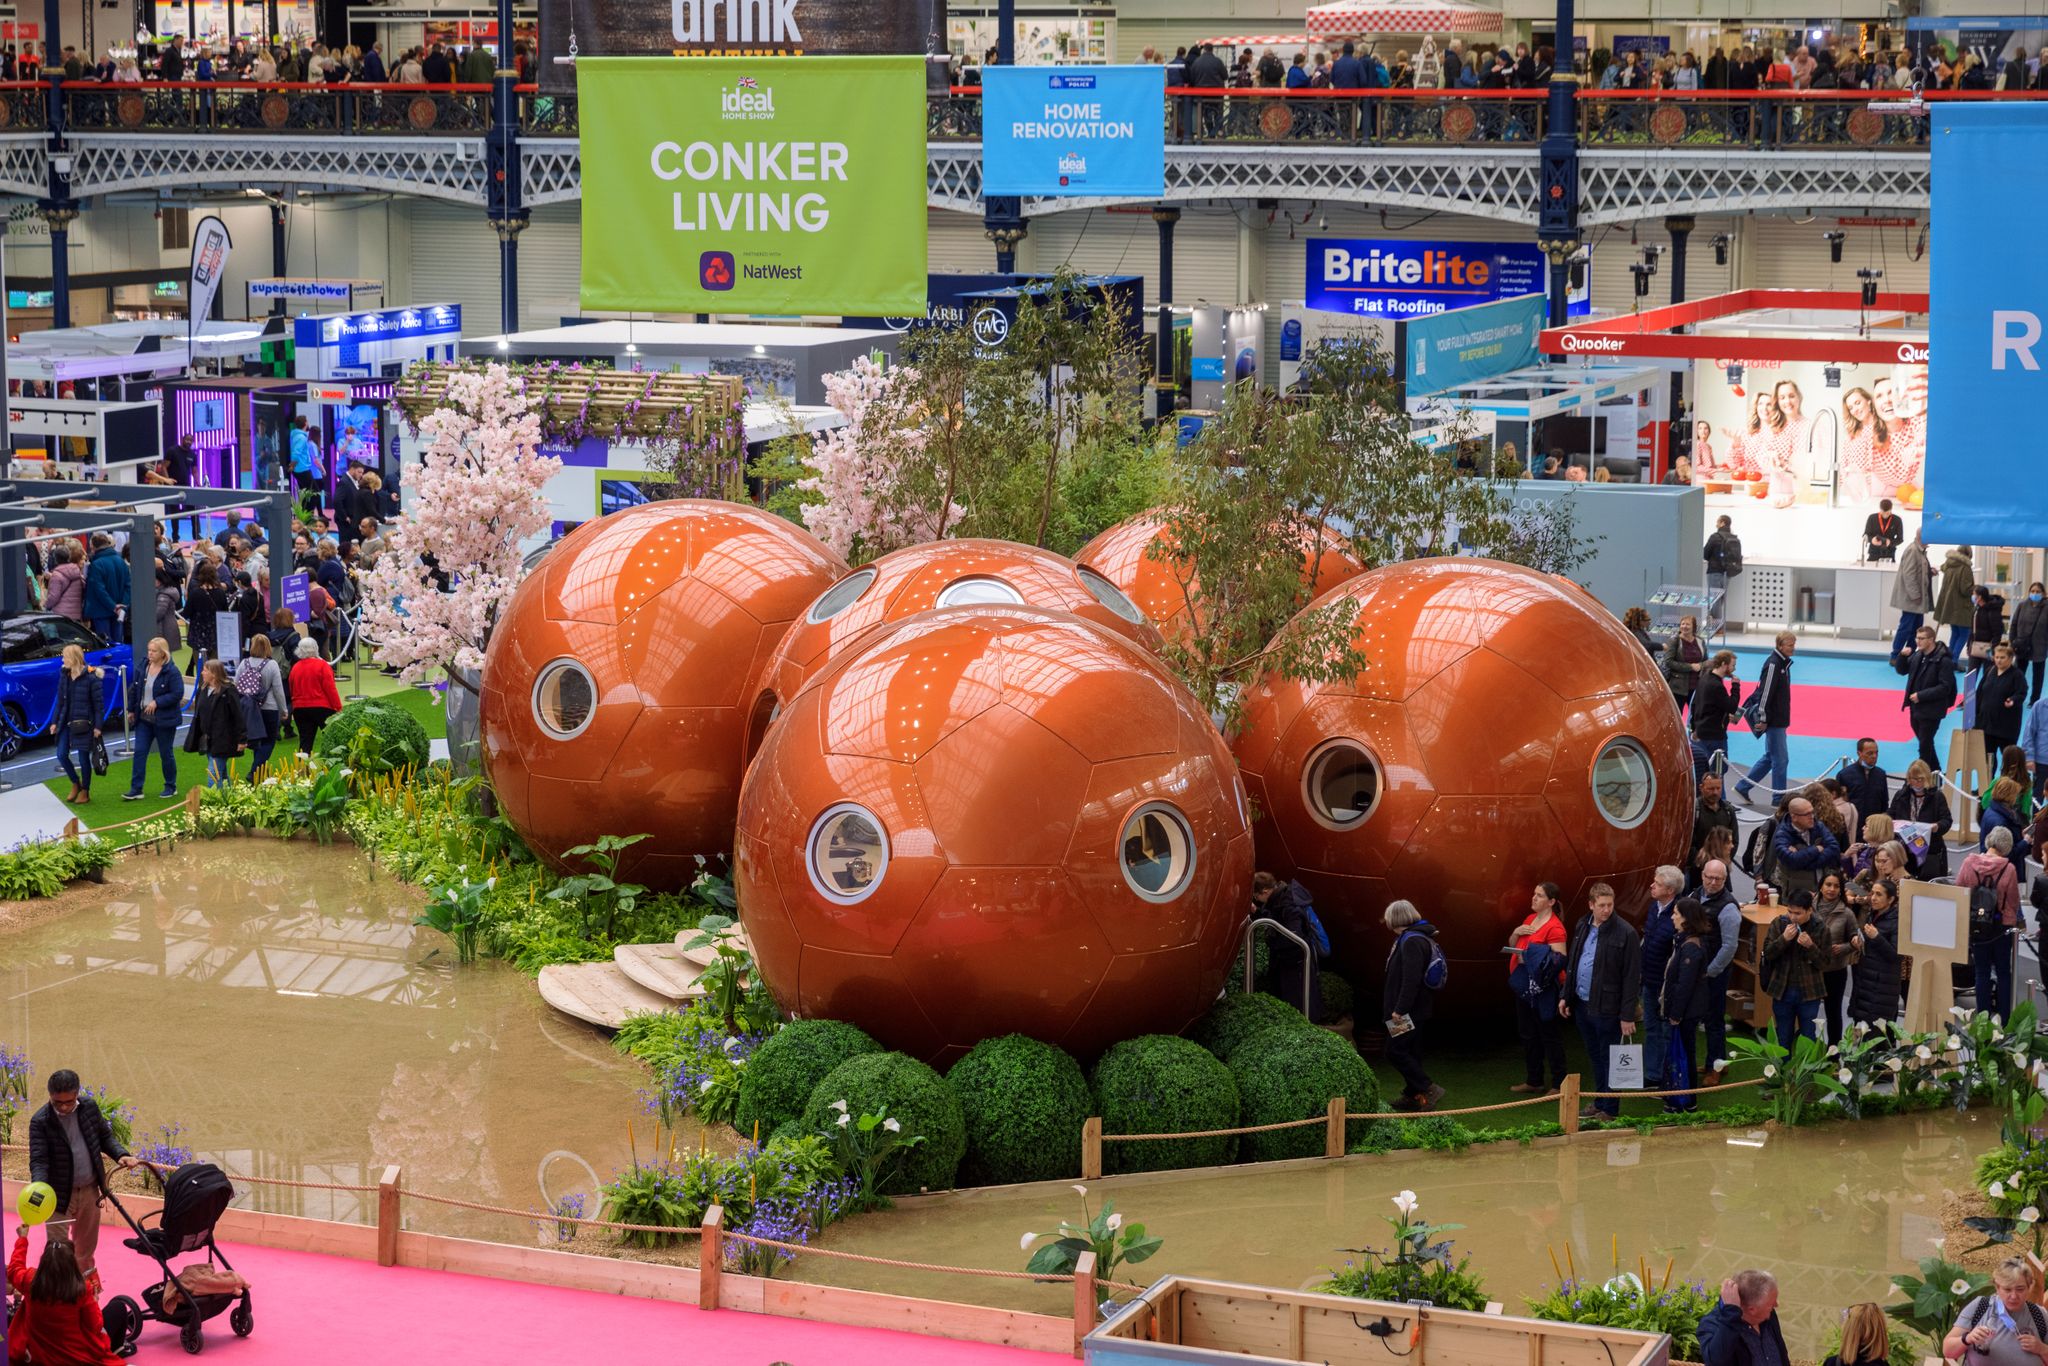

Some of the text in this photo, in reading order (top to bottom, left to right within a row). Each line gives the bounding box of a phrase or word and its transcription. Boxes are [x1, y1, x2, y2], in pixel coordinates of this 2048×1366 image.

[672, 0, 803, 43] drink
[722, 87, 775, 112] ideal
[1044, 103, 1101, 120] HOME
[1012, 122, 1134, 139] RENOVATION
[650, 141, 849, 181] CONKER
[1058, 157, 1087, 170] ideal
[673, 192, 829, 233] LIVING
[743, 264, 802, 280] NatWest
[1324, 248, 1489, 285] Britelite
[1354, 298, 1446, 313] Flat Roofing
[342, 317, 422, 335] Free Home Safety Advice
[976, 313, 1006, 334] TMG
[1437, 337, 1452, 352] YOUR
[1451, 334, 1466, 350] FULLY
[1465, 328, 1494, 346] INTEGRATED
[1494, 324, 1510, 341] SMART
[1509, 322, 1523, 336] HOME
[1560, 333, 1626, 353] Quooker
[1991, 310, 2042, 370] R
[1467, 346, 1485, 360] BEFORE
